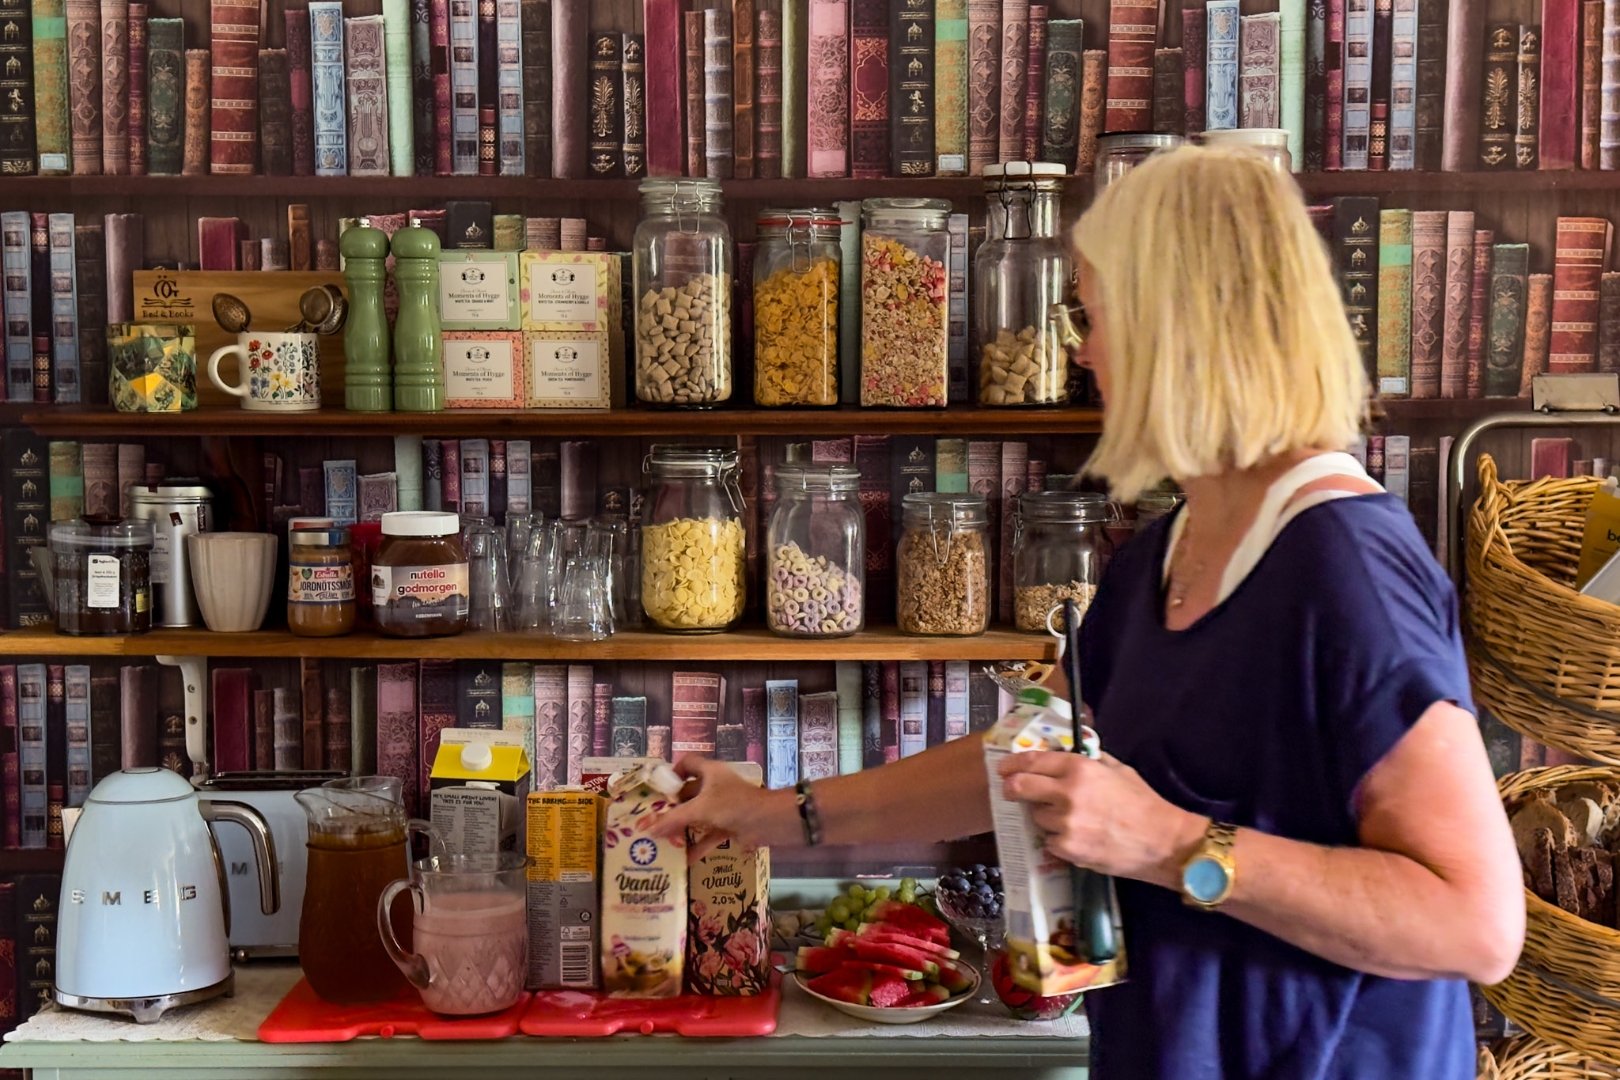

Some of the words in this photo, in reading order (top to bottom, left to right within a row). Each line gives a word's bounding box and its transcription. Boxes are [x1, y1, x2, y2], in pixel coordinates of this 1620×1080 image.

[169, 309, 194, 318] Books
[411, 570, 445, 580] nutella
[398, 583, 457, 595] godmorgen
[713, 863, 733, 875] Mild
[615, 873, 671, 896] Vanilj
[702, 872, 744, 890] Vanilj
[71, 886, 197, 906] SMEG
[620, 893, 666, 904] YOGHURT
